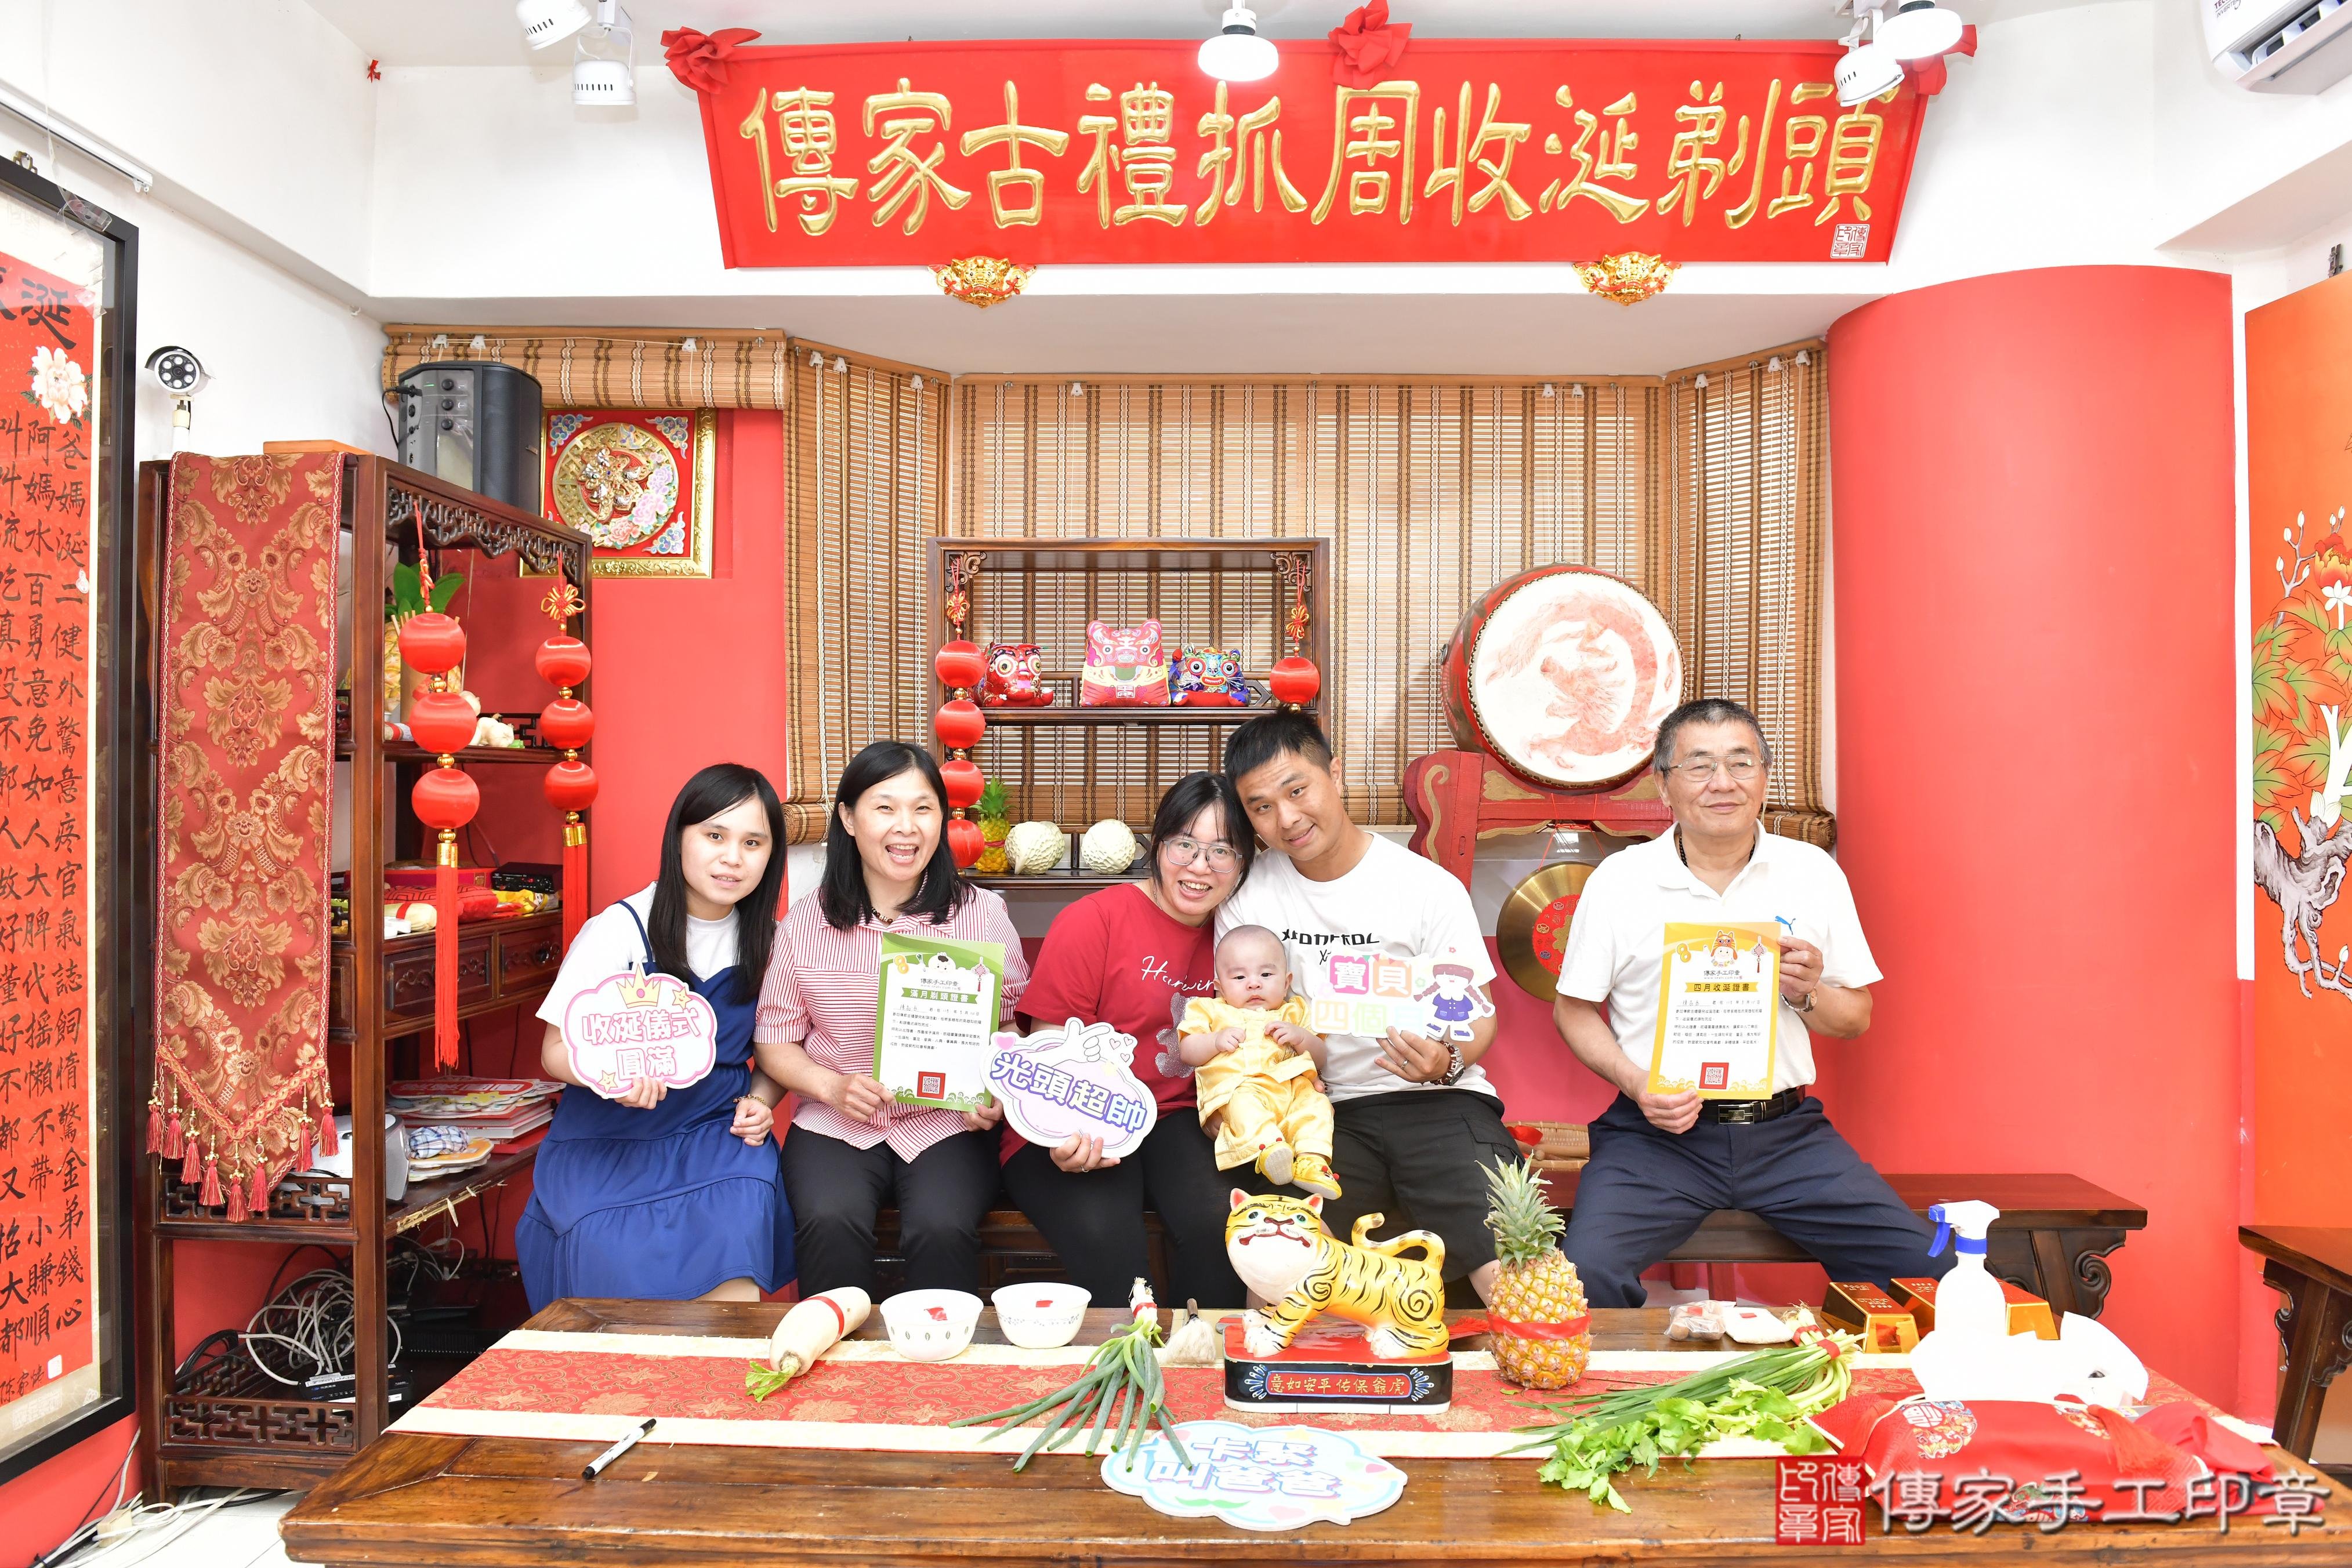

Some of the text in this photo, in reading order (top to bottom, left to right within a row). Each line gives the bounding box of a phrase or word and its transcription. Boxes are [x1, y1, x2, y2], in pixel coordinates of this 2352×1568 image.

[2215, 0, 2228, 9] TEC
[740, 77, 1898, 235] 傳家古禮抓周收涎剃頭
[1333, 961, 1408, 994] 寶貝
[582, 1008, 701, 1045] 收涎儀式
[616, 1046, 676, 1080] 圓滿
[990, 1052, 1147, 1133] 光頭超帥
[1145, 1461, 1342, 1499] 叫爸爸
